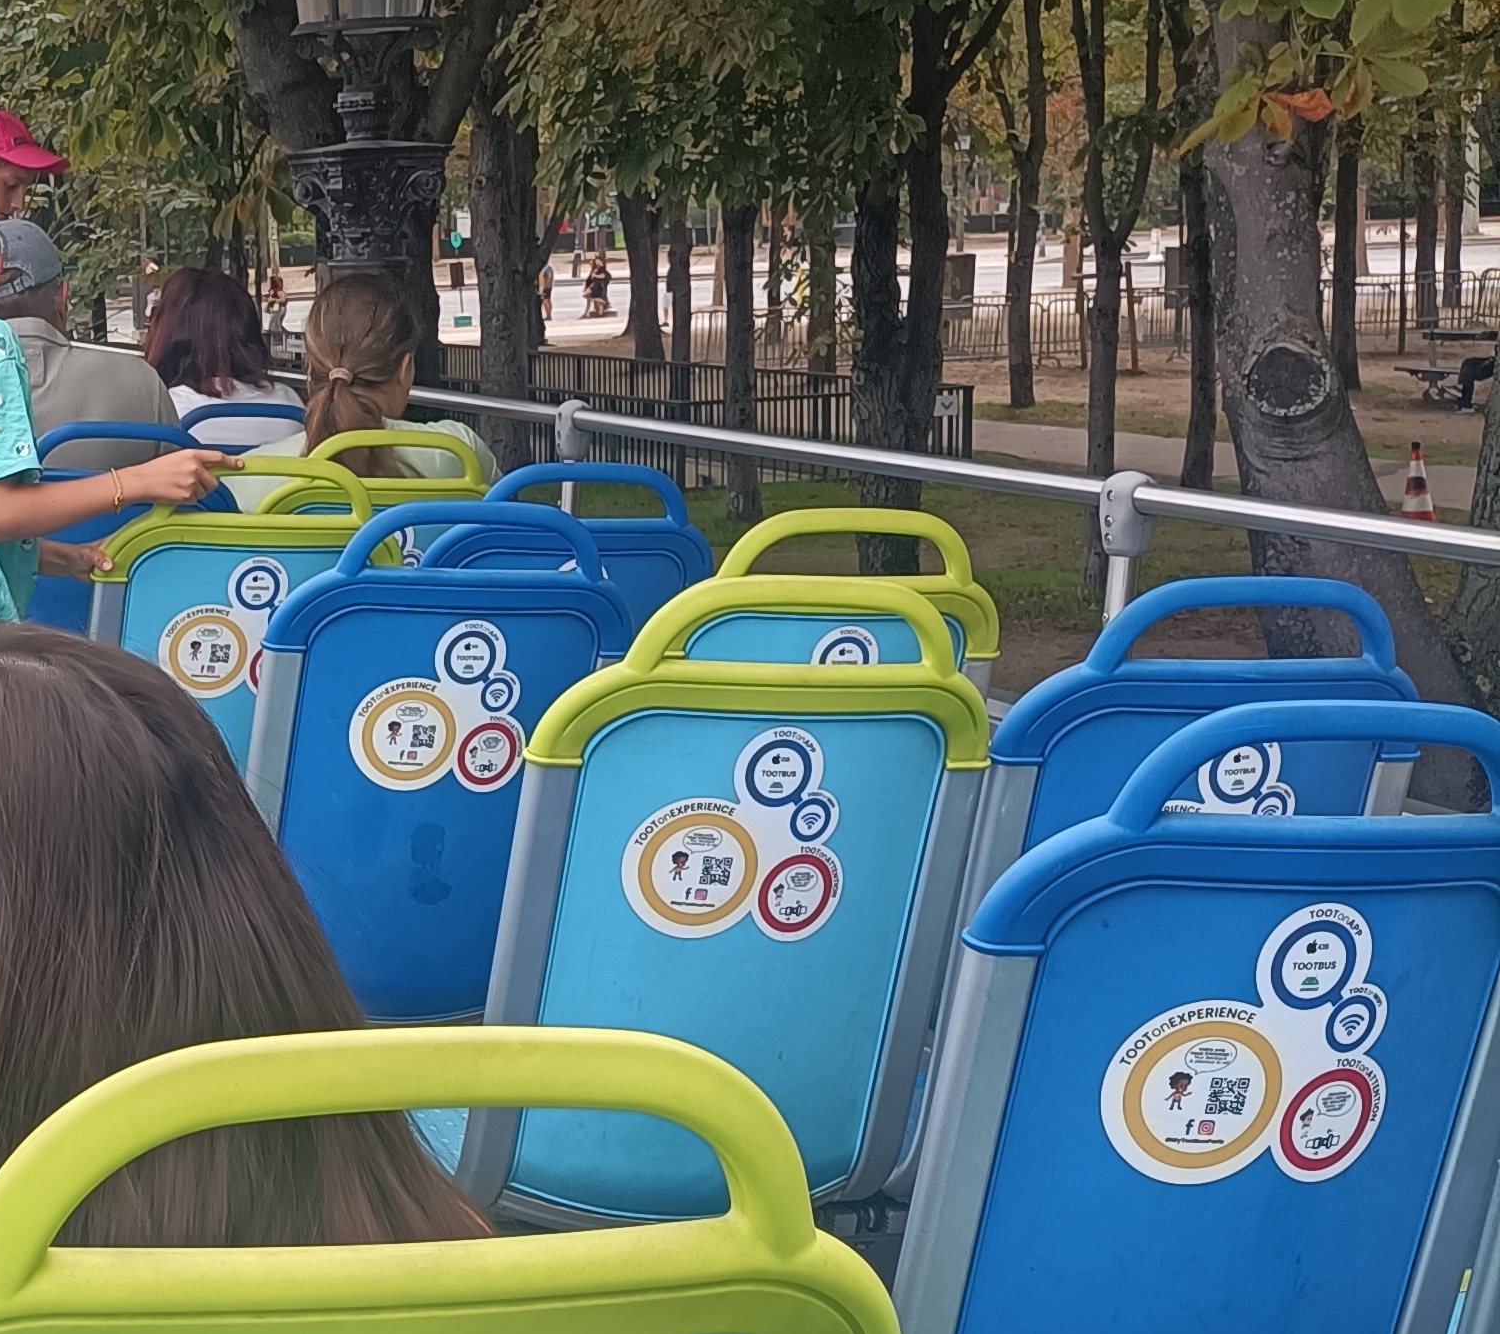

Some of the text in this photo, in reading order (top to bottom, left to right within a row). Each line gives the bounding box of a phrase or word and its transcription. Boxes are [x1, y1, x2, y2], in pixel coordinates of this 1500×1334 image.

[772, 730, 817, 753] TOOTonAPP
[761, 769, 797, 778] TOOTBUS
[634, 802, 737, 846] TOOTonEXPERIENCE
[1308, 909, 1363, 942] TOOTonAPP
[1291, 961, 1337, 971] TOOTBUS
[1119, 1007, 1257, 1067] TOOTonEXPERIENCE
[1335, 1058, 1380, 1123] TOOTonATTENTION
